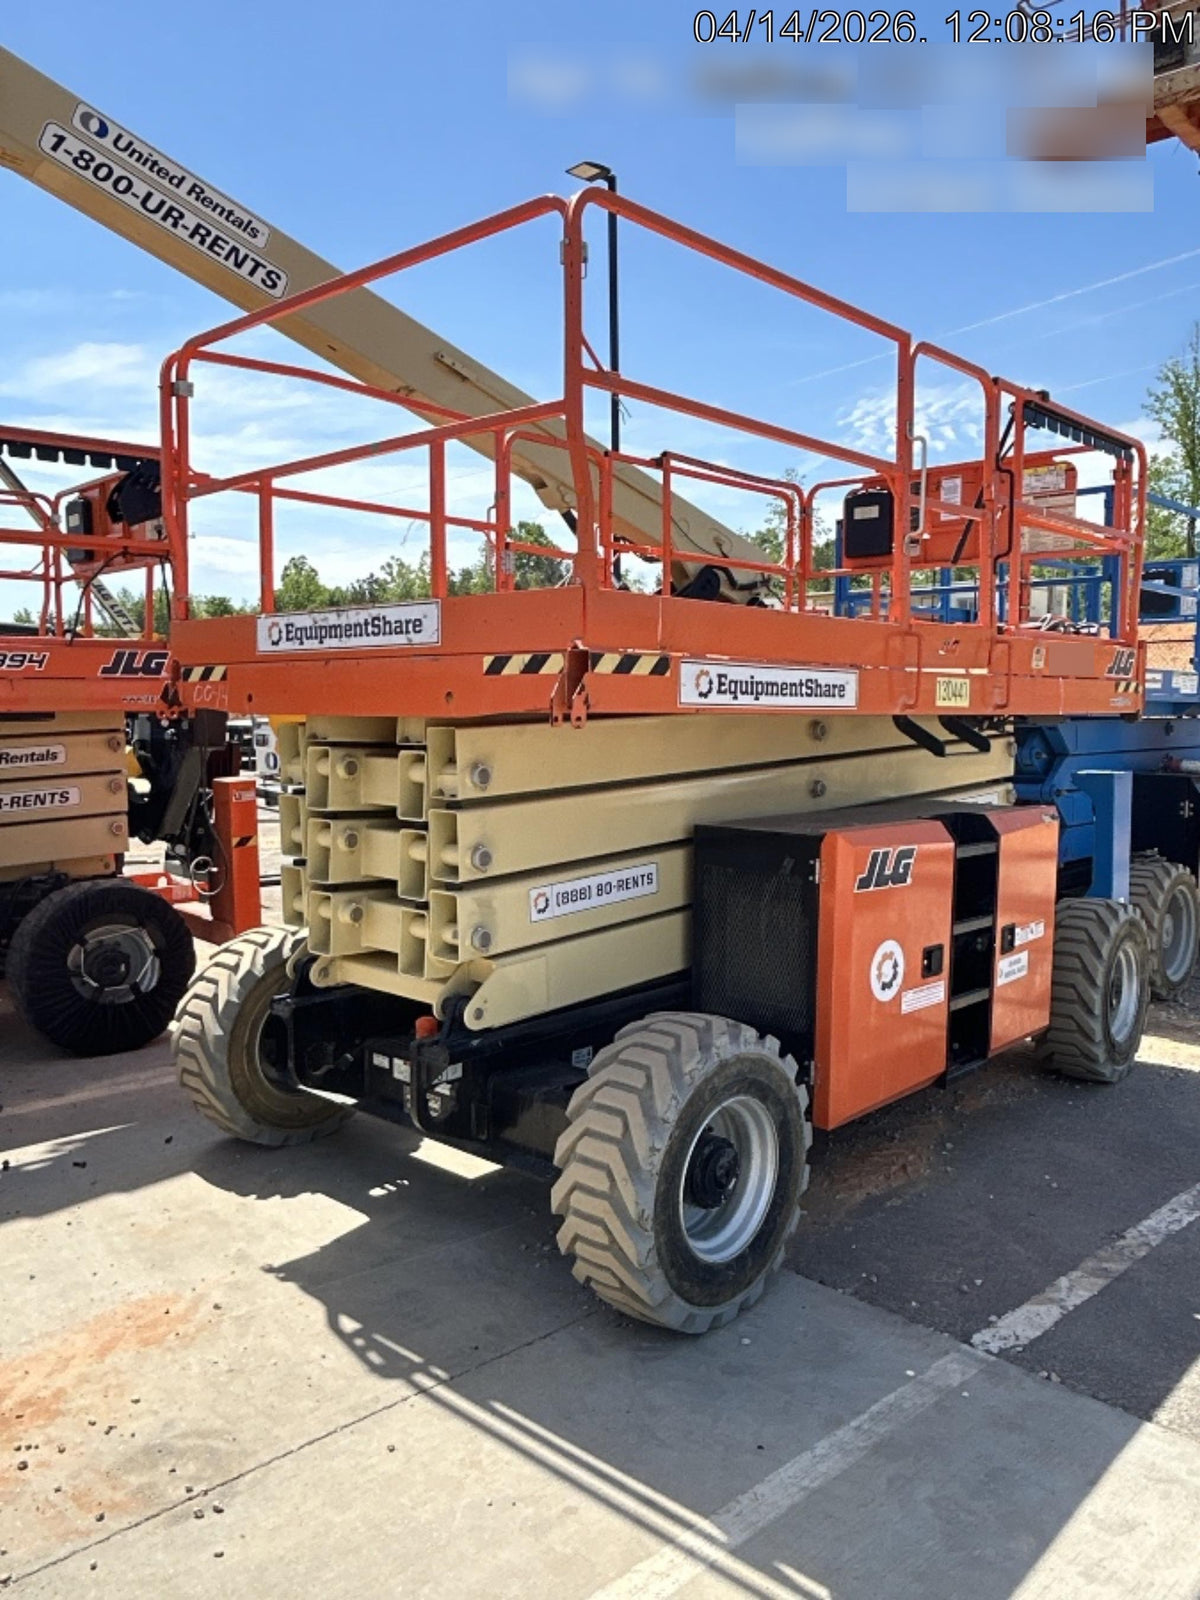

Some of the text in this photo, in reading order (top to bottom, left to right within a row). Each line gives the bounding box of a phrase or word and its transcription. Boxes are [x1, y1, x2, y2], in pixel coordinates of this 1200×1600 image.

[113, 132, 261, 240] United Rentals
[50, 133, 282, 291] 1-800-UR-RENTS
[284, 615, 423, 646] EquipmentShare
[100, 650, 170, 676] JLG
[1107, 649, 1135, 676] JLG
[716, 674, 846, 701] EquipmentShare
[0, 749, 58, 765] Rentals
[0, 791, 70, 810] -RENTS
[856, 848, 917, 891] JLG
